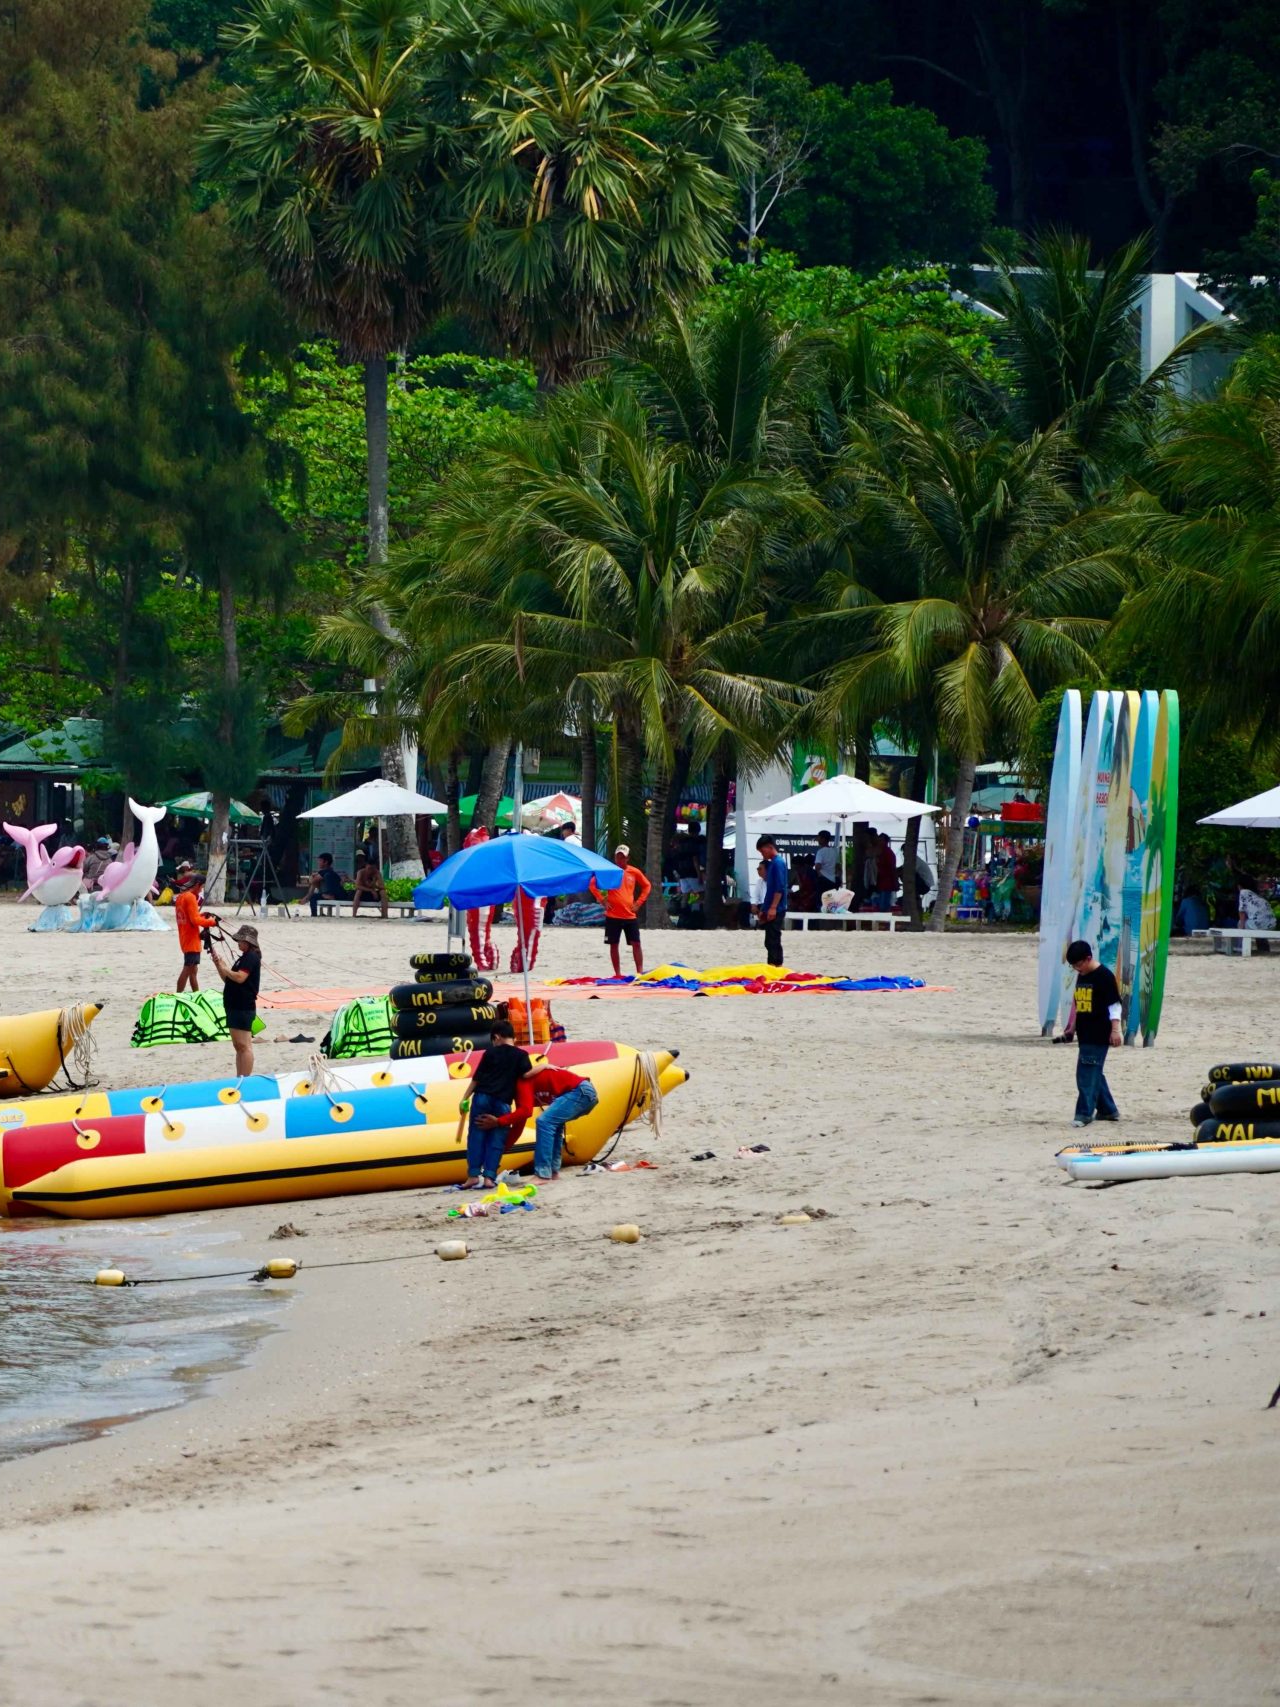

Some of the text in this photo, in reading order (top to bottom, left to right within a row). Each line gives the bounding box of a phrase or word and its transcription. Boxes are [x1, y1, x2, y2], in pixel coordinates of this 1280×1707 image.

[416, 1012, 437, 1027] 30
[398, 1036, 474, 1057] NAI 30
[1216, 1123, 1255, 1142] NAI
